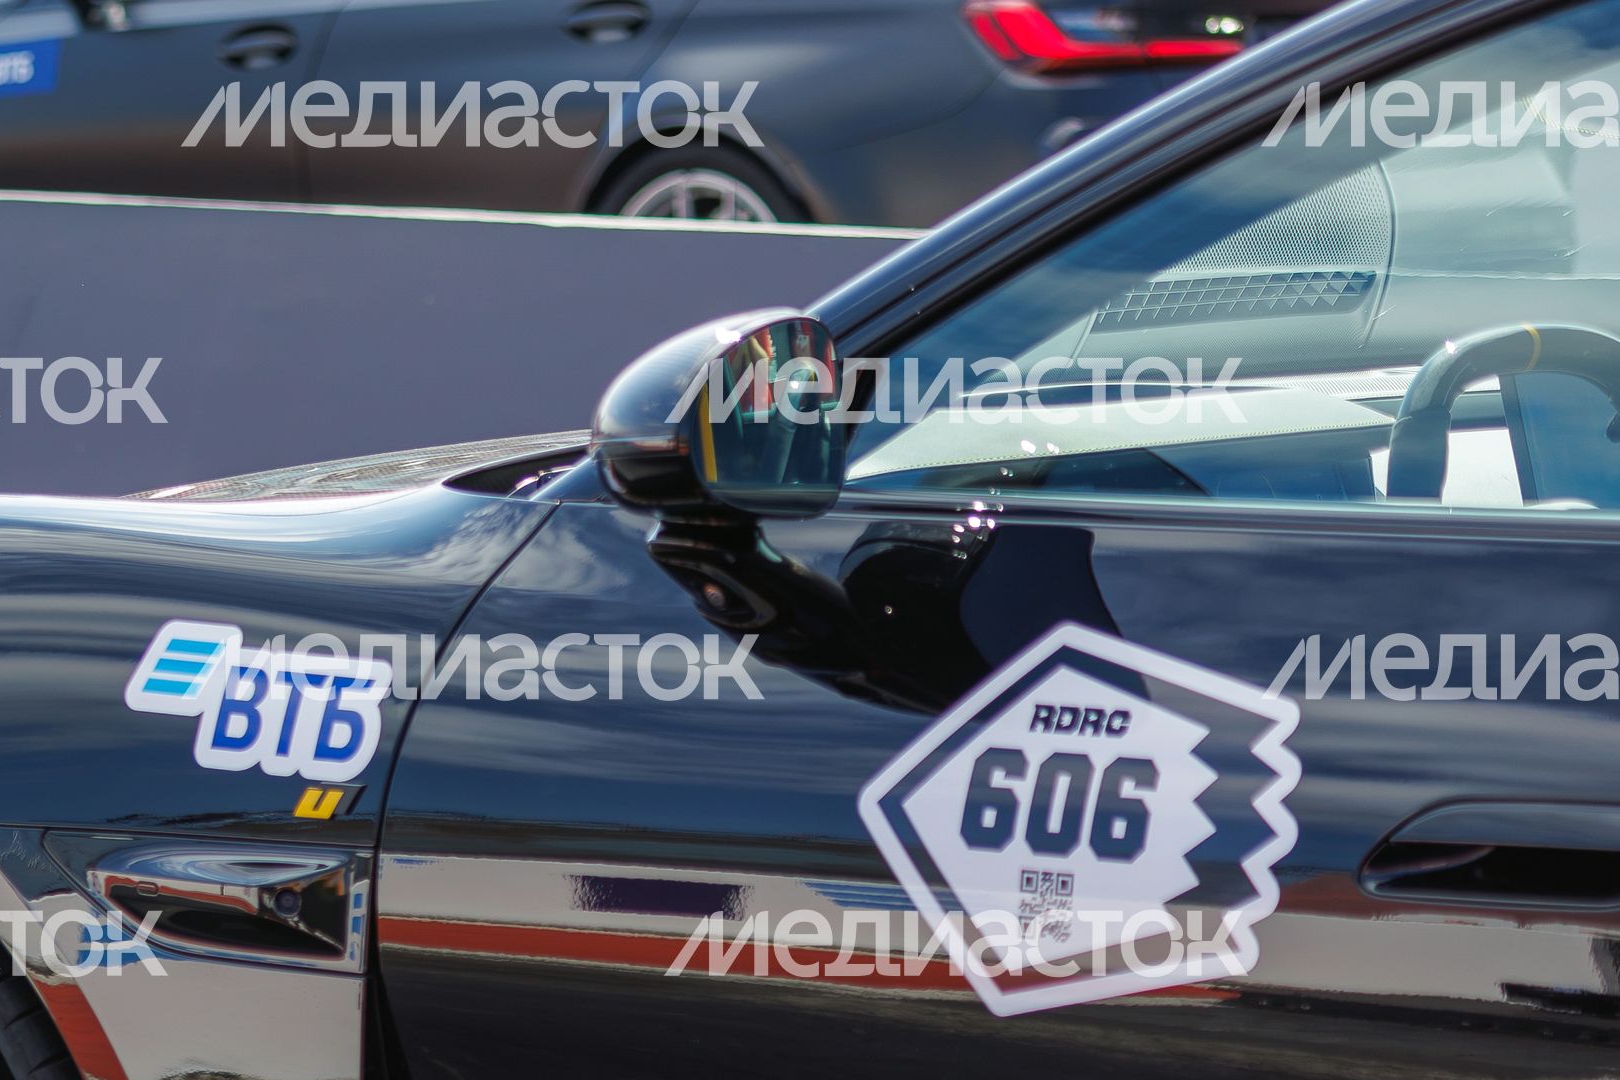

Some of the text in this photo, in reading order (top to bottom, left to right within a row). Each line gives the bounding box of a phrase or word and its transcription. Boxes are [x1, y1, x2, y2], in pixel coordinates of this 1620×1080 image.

[210, 664, 377, 763] ВТБ
[1029, 704, 1132, 739] RDRC
[960, 746, 1161, 865] 606
